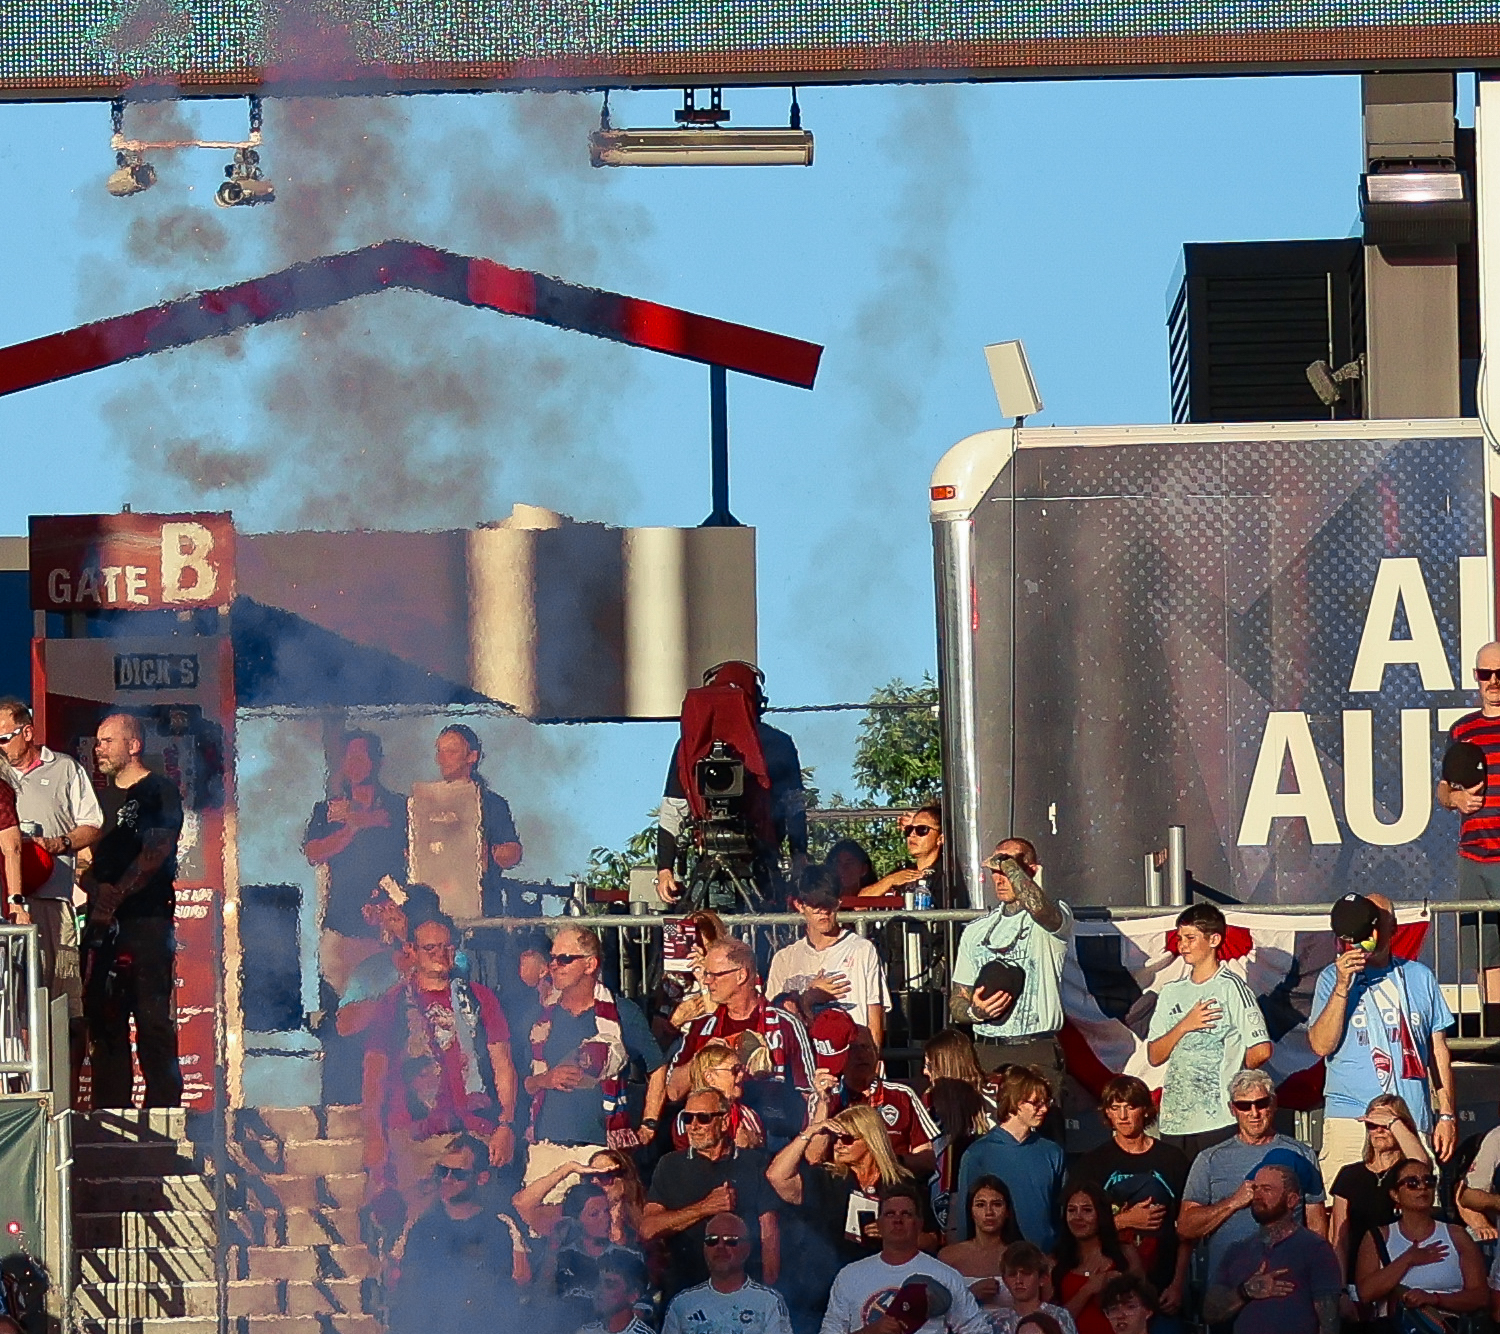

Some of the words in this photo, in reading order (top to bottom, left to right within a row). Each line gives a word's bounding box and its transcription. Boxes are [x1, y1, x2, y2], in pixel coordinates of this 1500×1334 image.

[159, 521, 218, 604] B
[47, 565, 150, 606] GATE
[118, 654, 196, 689] DICKS
